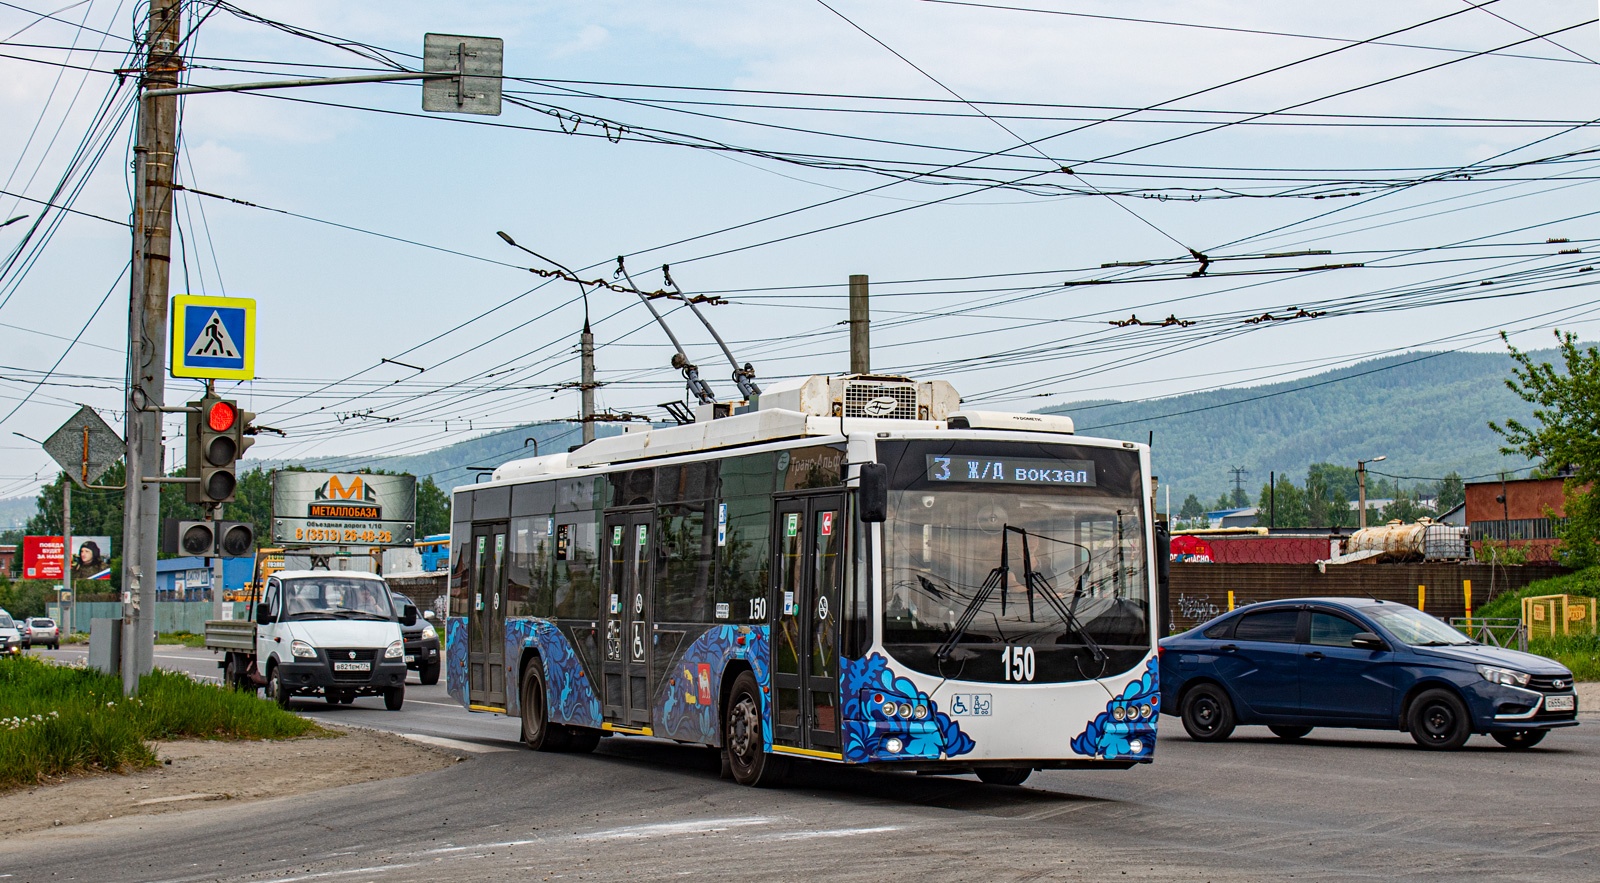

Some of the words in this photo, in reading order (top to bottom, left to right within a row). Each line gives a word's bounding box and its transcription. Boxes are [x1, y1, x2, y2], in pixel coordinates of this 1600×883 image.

[934, 457, 951, 480] 3
[967, 461, 1004, 479] Ж/Д
[1015, 468, 1088, 483] вокзал
[315, 475, 377, 503] КМС
[312, 506, 378, 518] МЕТАЛЛОБАЗА
[296, 528, 304, 541] 8
[306, 529, 342, 543] (3513)
[344, 530, 392, 543] 26-48-26
[306, 521, 342, 529] Объездная
[749, 597, 767, 620] 150
[1001, 646, 1036, 681] 150
